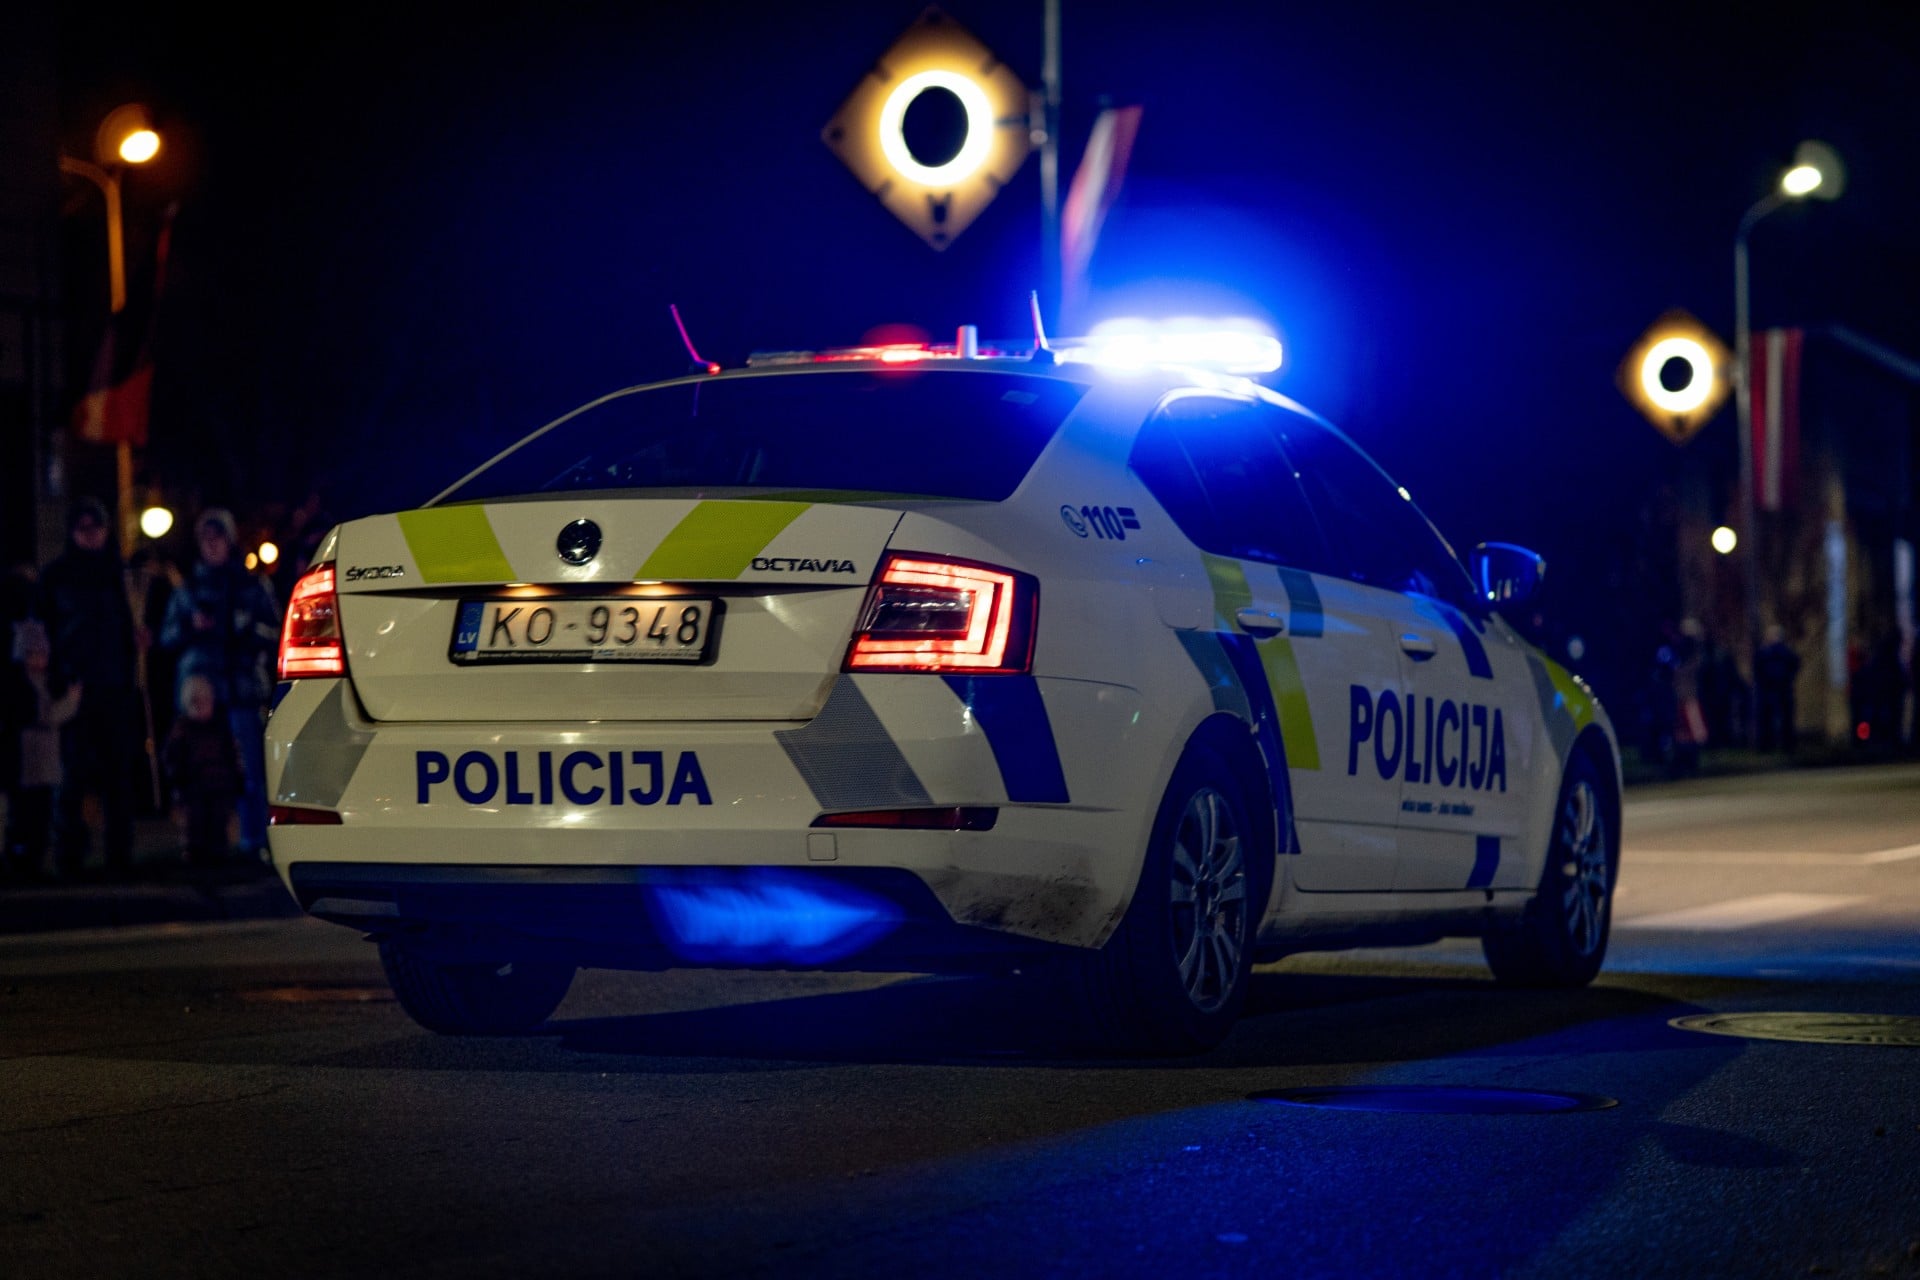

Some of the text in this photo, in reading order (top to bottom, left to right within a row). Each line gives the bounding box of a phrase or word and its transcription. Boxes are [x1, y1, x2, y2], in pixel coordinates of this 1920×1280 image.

[751, 558, 856, 574] OCTAVIA
[458, 631, 478, 644] LV
[1348, 684, 1507, 793] POLICIJA
[416, 750, 713, 806] POLICIJA
